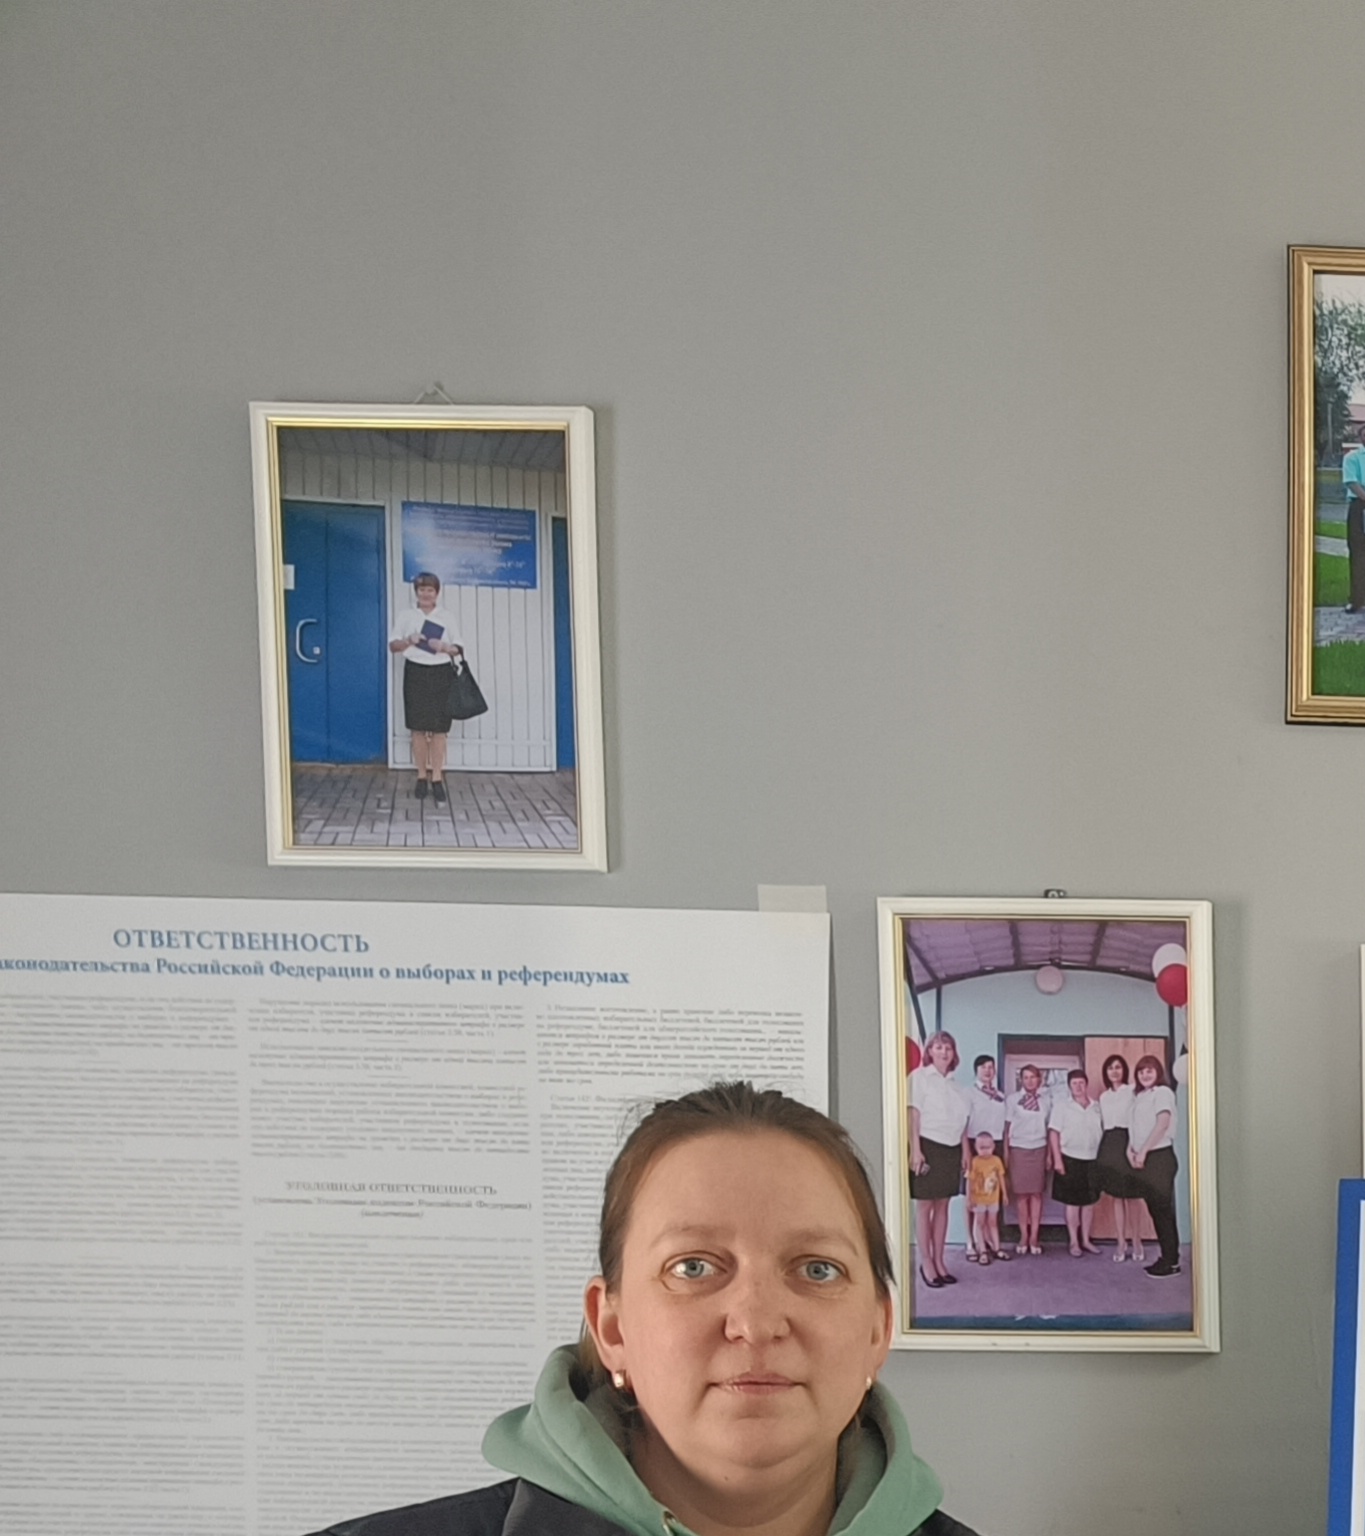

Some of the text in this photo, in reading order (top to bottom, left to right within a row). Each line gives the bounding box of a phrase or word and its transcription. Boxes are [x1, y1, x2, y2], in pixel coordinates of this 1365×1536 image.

[112, 929, 369, 953] ОТВЕТСТВЕННОСТЬ
[156, 958, 265, 977] Российской
[269, 962, 375, 980] Федерации
[378, 967, 391, 979] о
[395, 967, 476, 981] выборах
[481, 969, 493, 981] и
[497, 969, 629, 988] референдумах
